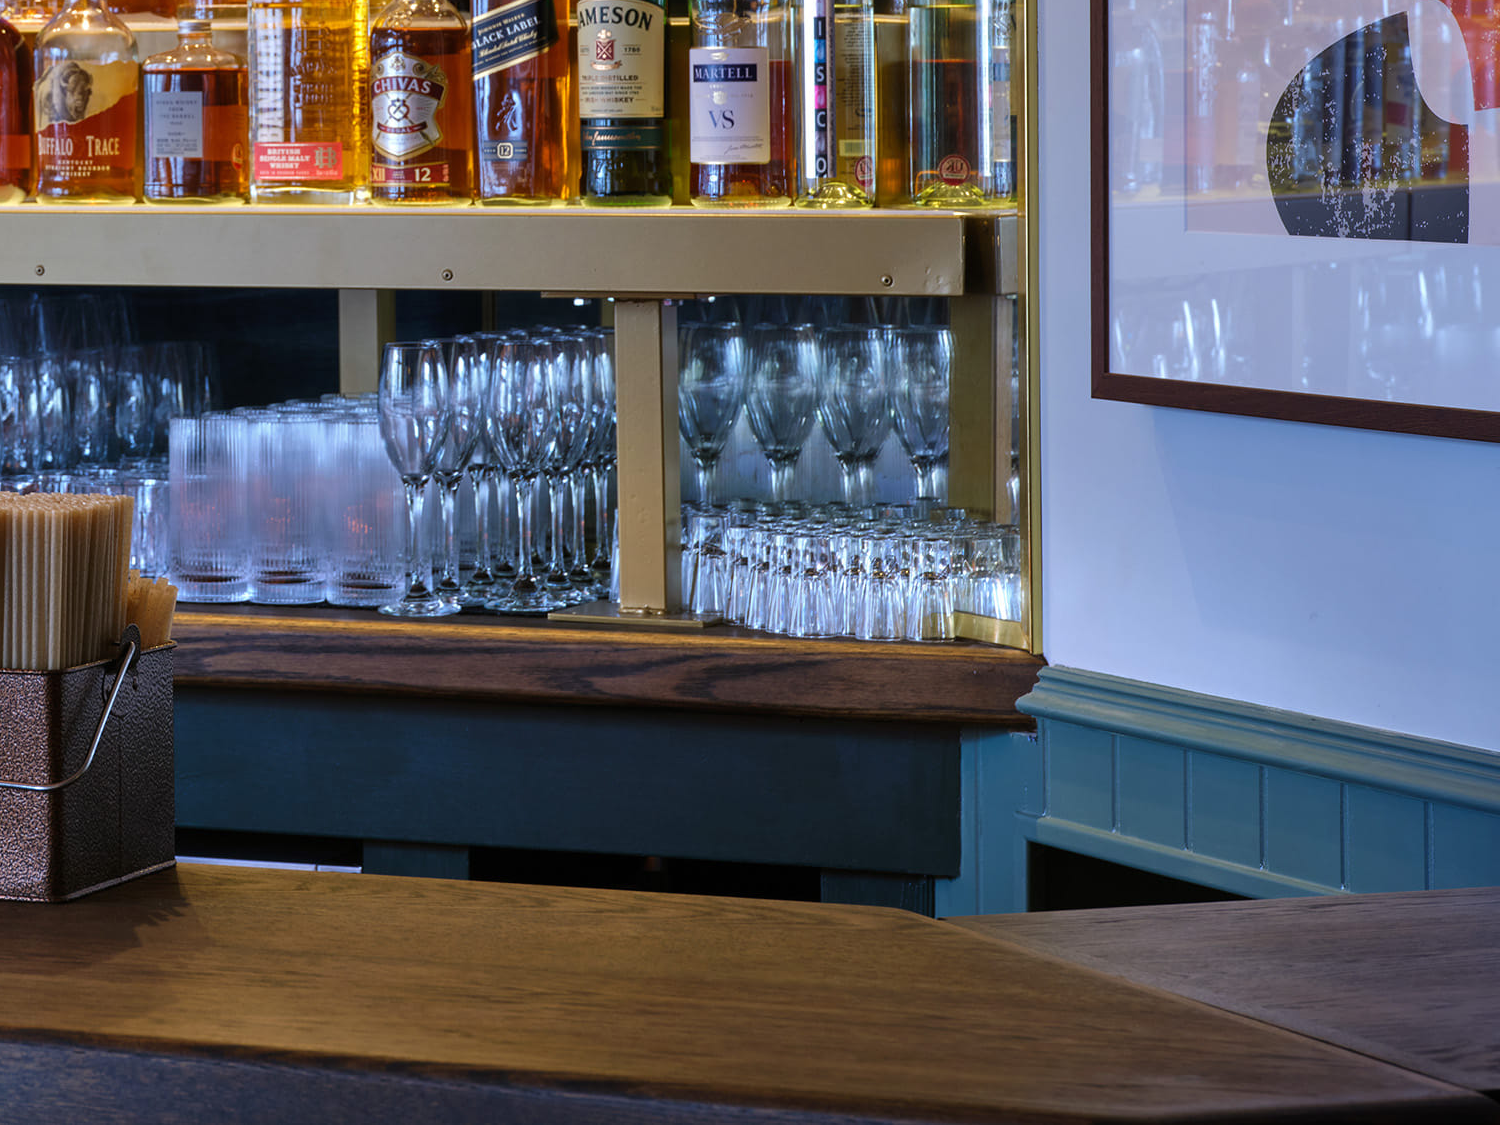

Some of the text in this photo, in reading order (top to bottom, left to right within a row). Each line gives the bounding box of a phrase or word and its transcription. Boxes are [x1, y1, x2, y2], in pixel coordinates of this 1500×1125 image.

[505, 15, 539, 36] LABEL
[578, 5, 653, 32] AMESON
[694, 66, 753, 79] MARTELL
[373, 77, 432, 94] CHIVAS
[708, 109, 735, 130] VS
[86, 135, 121, 158] TRACE
[499, 145, 510, 156] 12
[414, 167, 432, 182] 12
